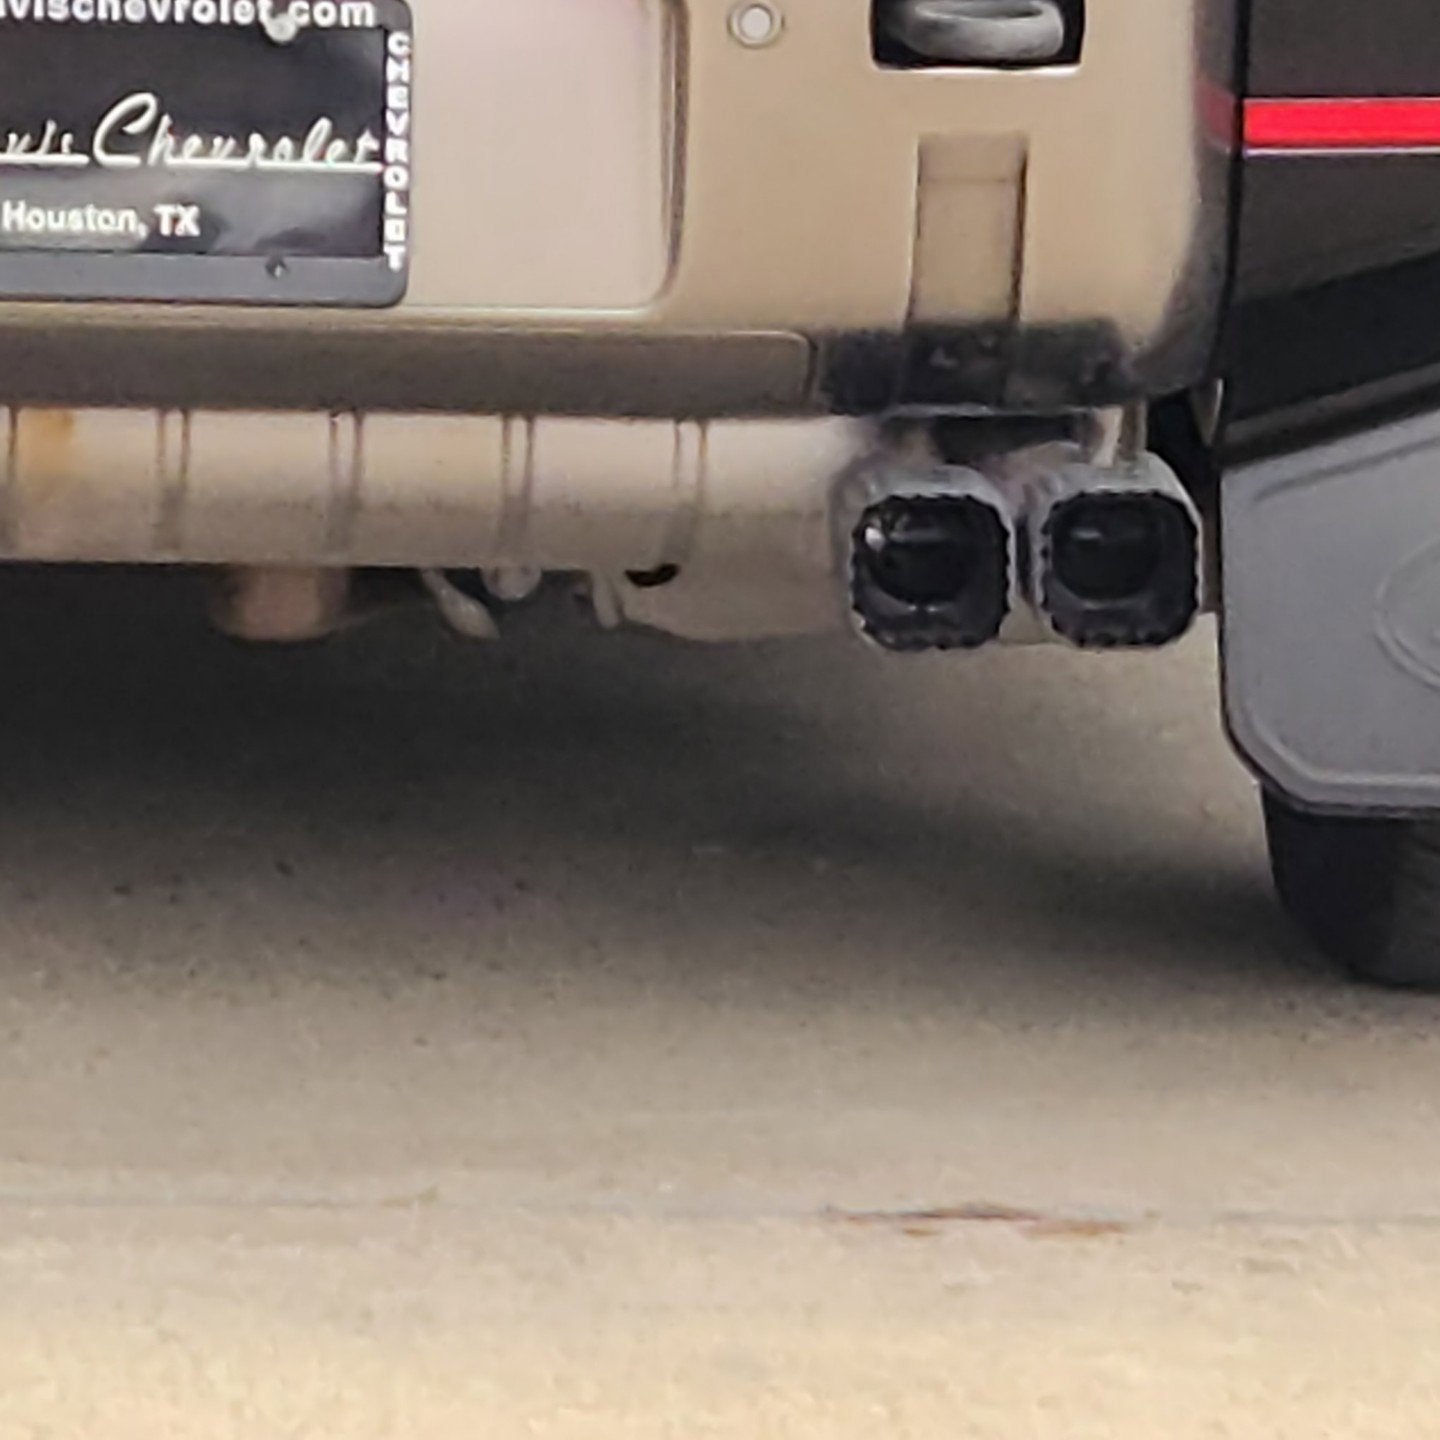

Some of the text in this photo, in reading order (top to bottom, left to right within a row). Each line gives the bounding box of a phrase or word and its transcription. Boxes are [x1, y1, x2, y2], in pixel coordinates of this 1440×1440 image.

[92, 91, 382, 171] Chevrolet
[383, 31, 411, 271] CHEVROLET
[1, 200, 201, 241] Houston, TX
